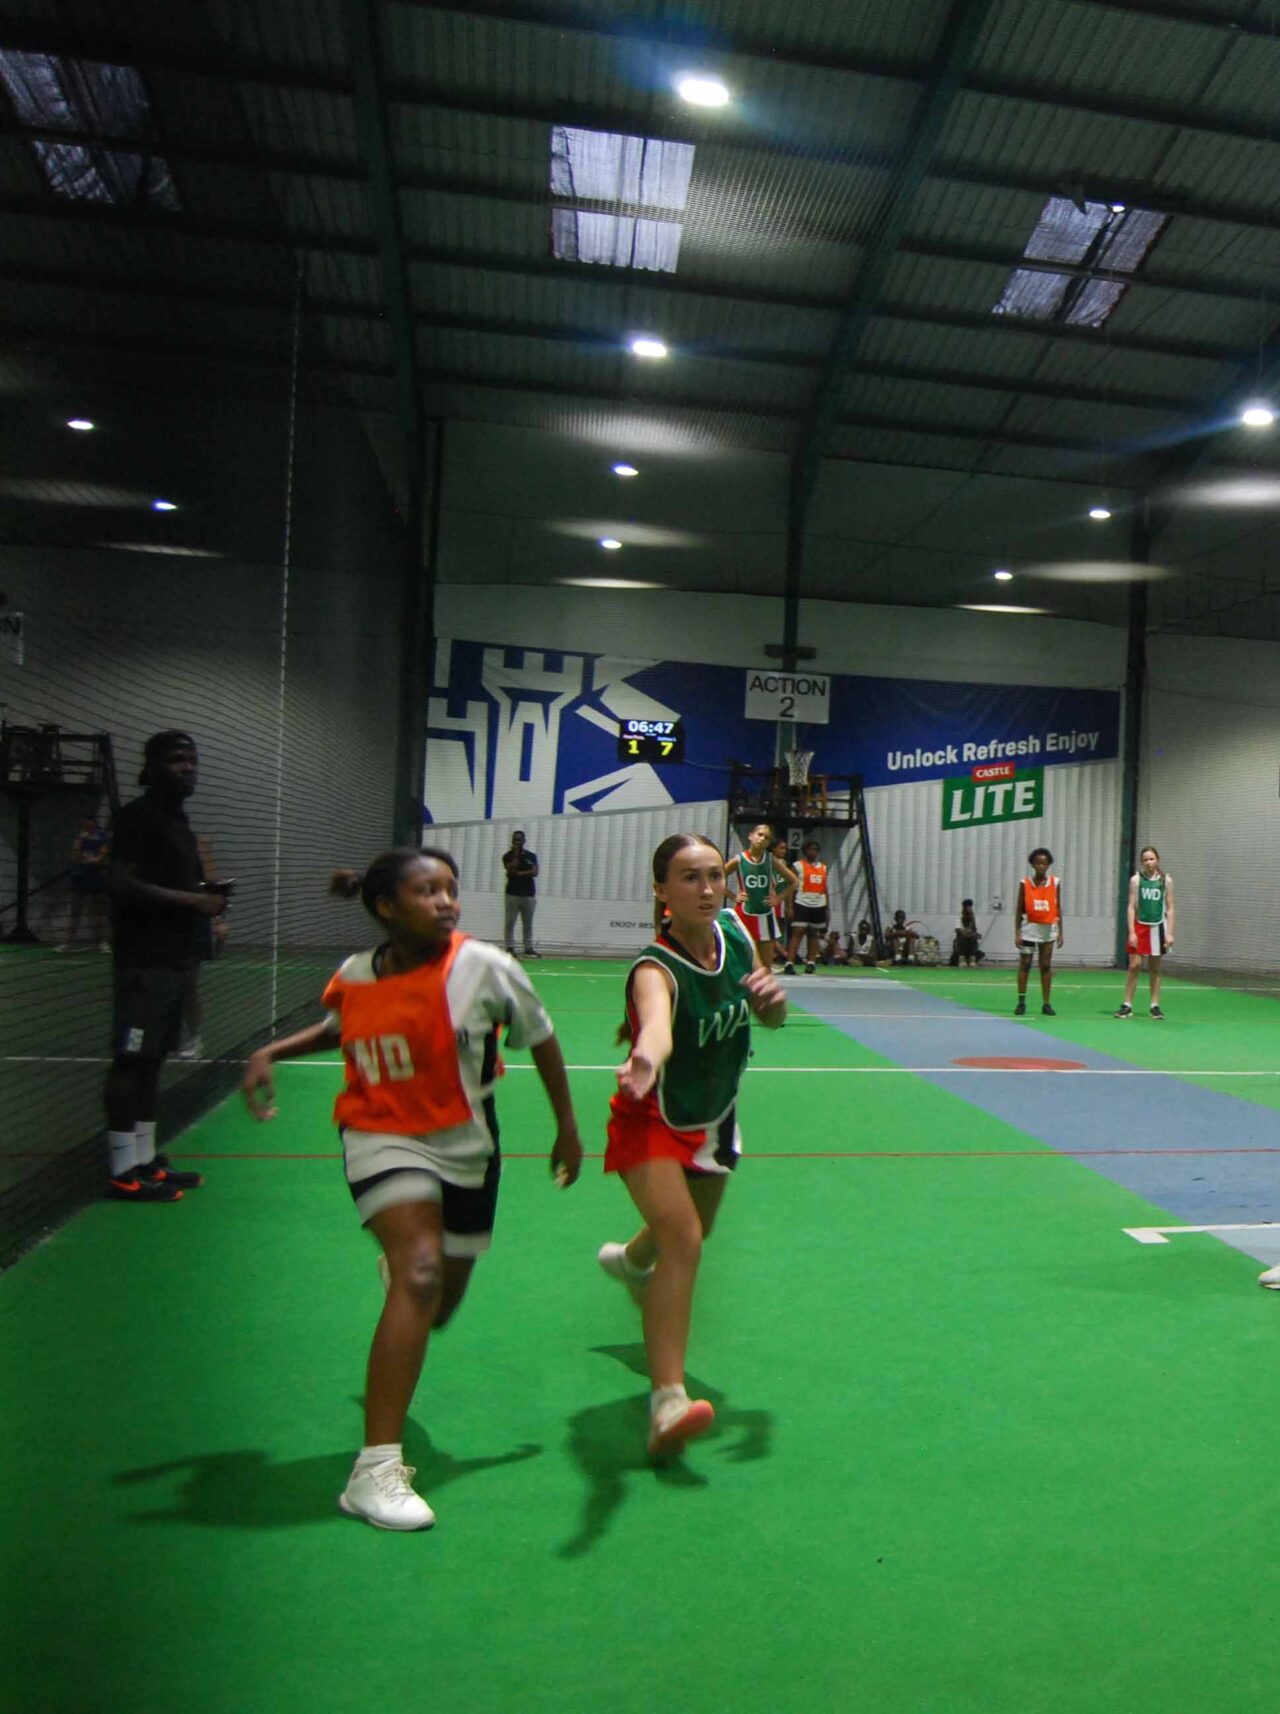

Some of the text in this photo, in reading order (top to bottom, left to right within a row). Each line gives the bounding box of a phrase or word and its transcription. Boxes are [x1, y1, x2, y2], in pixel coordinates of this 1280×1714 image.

[750, 675, 826, 696] ACTION
[779, 697, 795, 718] 2
[628, 720, 674, 734] 06:47
[628, 740, 673, 756] 1 7
[887, 731, 1099, 770] Unlock Refresh Enjoy
[976, 766, 1010, 778] CASTLE
[950, 780, 1036, 822] LITE
[792, 832, 799, 847] 2
[745, 874, 768, 889] GD
[1141, 887, 1161, 900] WD
[698, 998, 750, 1047] WA
